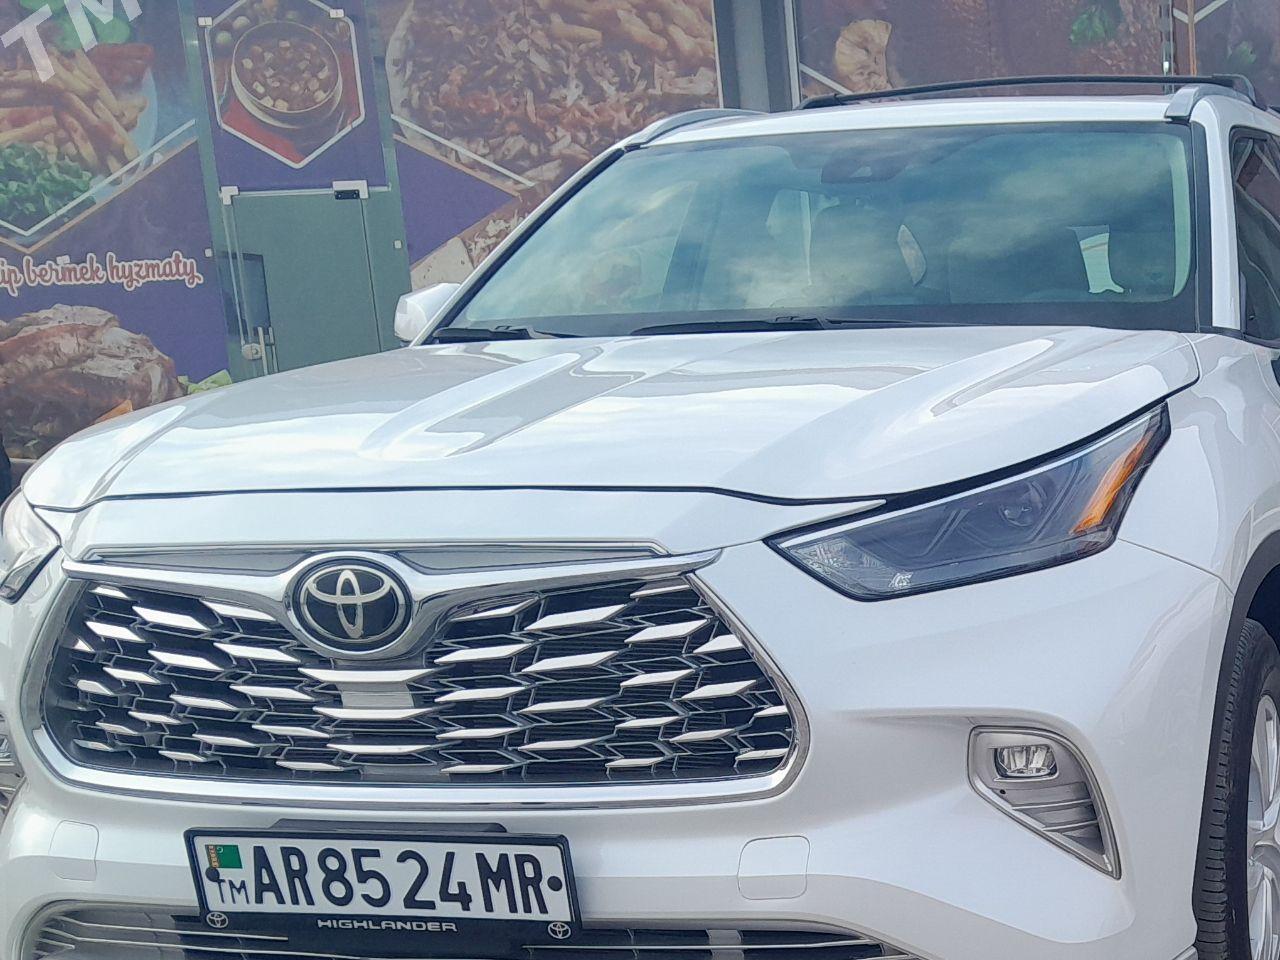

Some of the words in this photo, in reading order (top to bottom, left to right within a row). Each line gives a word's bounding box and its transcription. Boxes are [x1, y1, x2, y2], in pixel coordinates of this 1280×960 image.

[23, 252, 106, 287] bermek
[108, 250, 203, 291] hyzmaty
[317, 918, 458, 932] HIGHLANDER
